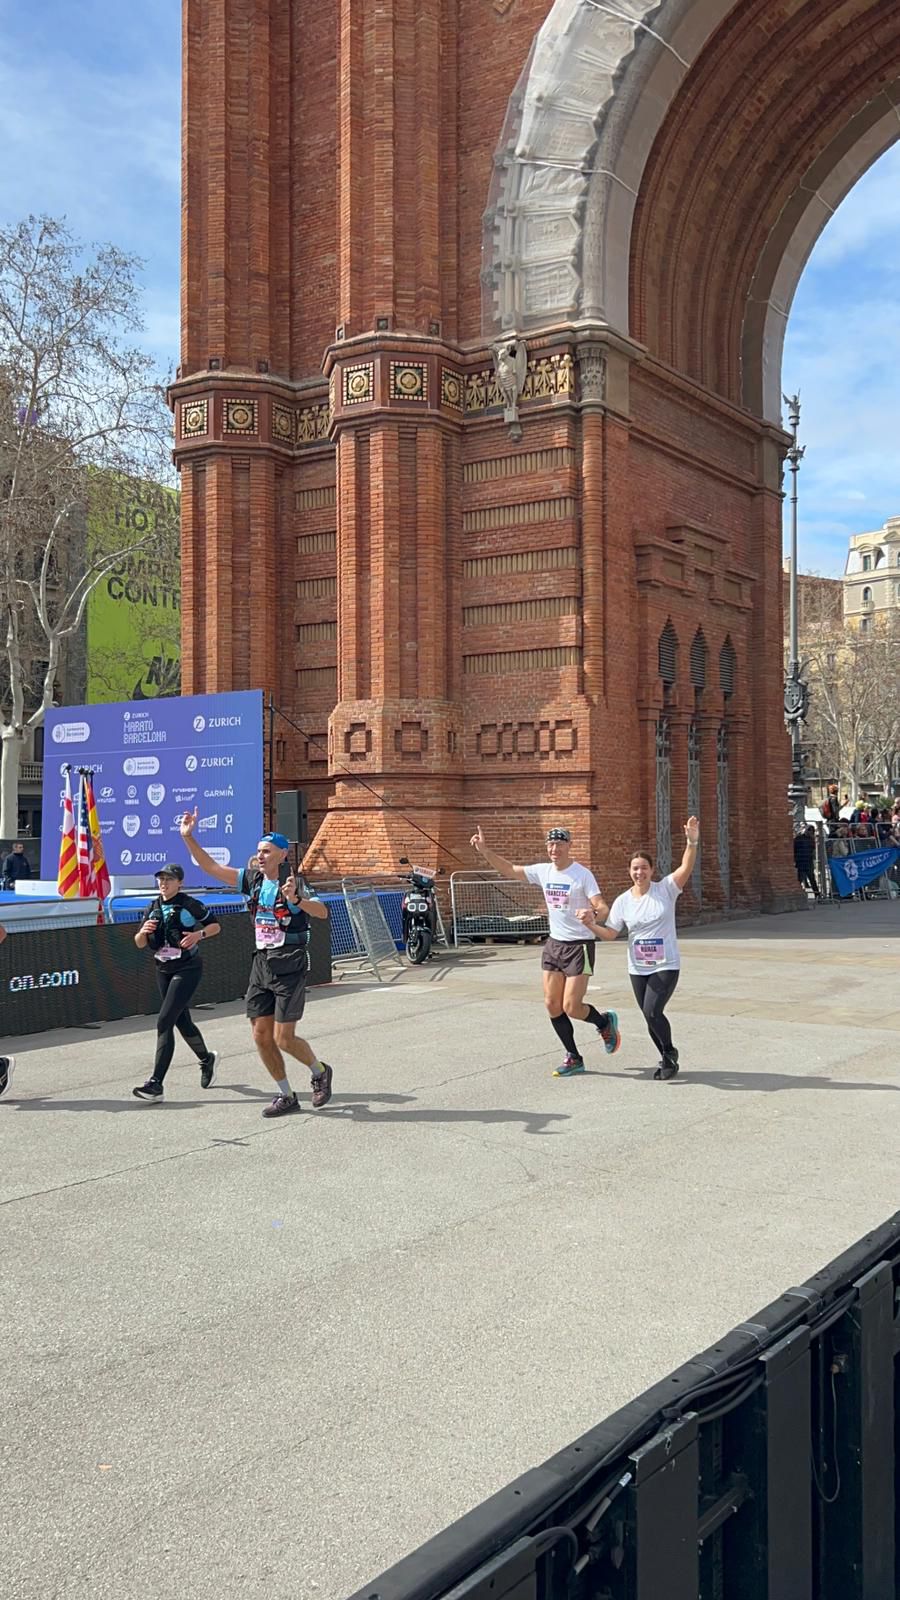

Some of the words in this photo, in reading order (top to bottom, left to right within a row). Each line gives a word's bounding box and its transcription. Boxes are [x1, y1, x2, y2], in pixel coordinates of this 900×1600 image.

[209, 716, 241, 728] ZURICH
[123, 730, 167, 744] BARCELONA
[201, 756, 234, 768] ZURICH
[203, 788, 234, 798] GARMIN
[135, 852, 167, 863] ZURICH
[9, 969, 80, 992] on.com
